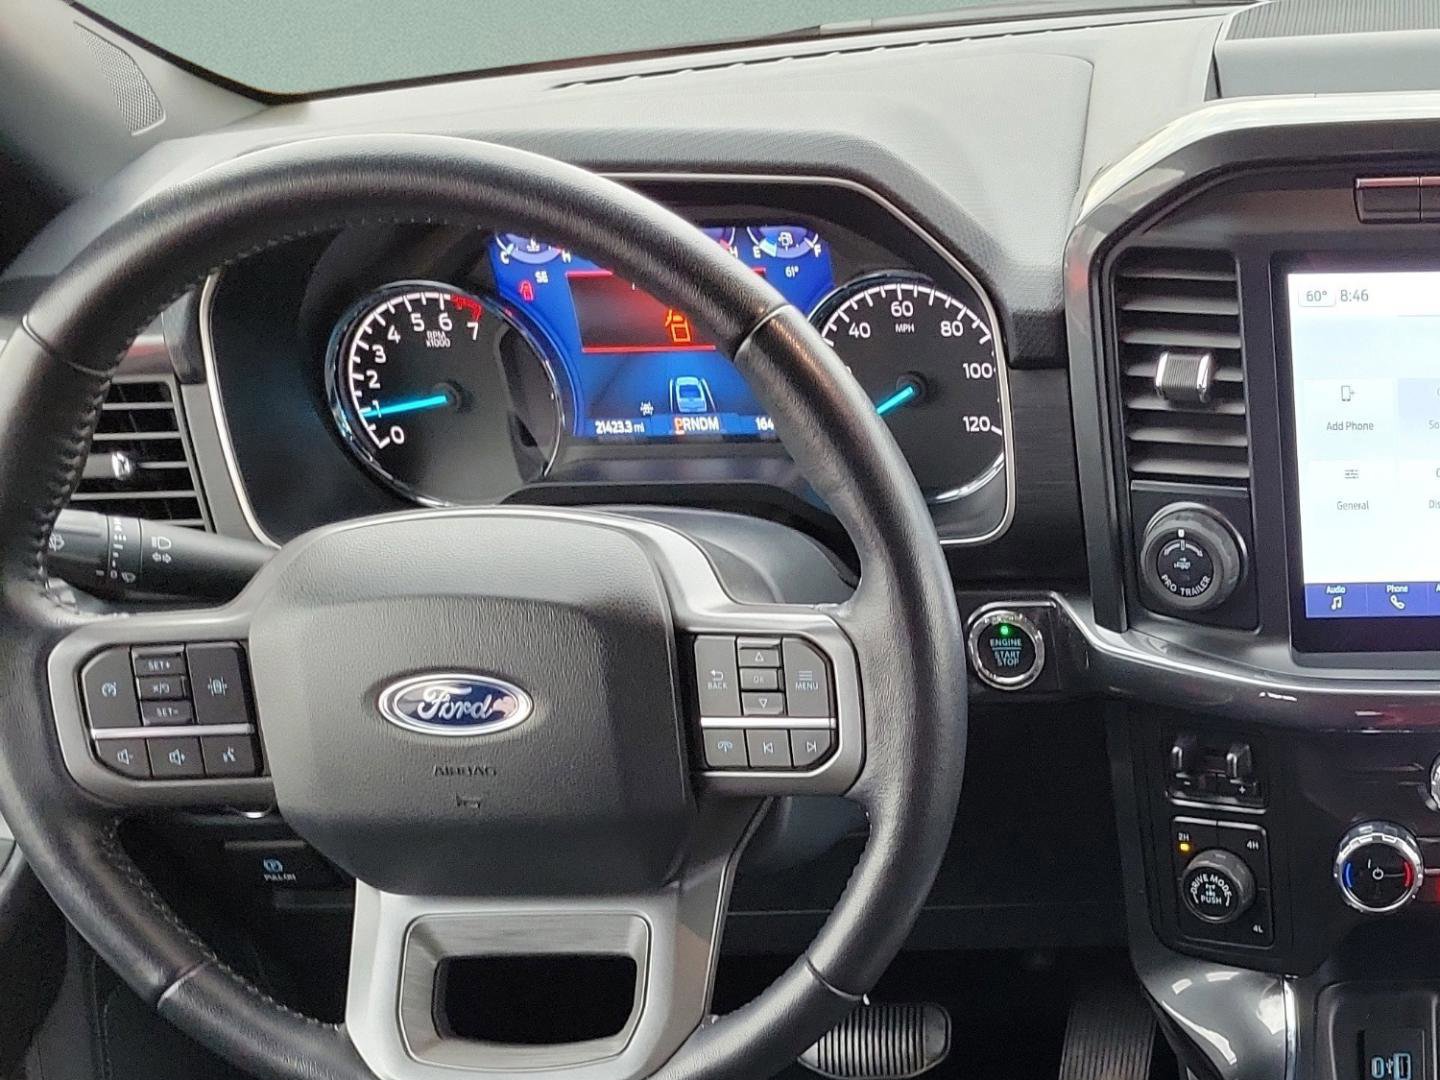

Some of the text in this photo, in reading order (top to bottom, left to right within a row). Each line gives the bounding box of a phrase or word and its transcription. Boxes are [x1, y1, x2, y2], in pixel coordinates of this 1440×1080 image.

[1306, 290, 1328, 302] 60°
[1340, 288, 1369, 303] 8:46
[891, 301, 914, 318] 60
[411, 313, 425, 331] 5
[438, 312, 453, 331] 6
[895, 323, 915, 333] MPH
[940, 321, 964, 337] 80
[387, 325, 401, 344] 4
[426, 330, 447, 341] RPM
[466, 321, 479, 340] 7
[849, 322, 871, 338] 40
[372, 344, 386, 363] 3
[963, 363, 993, 379] 100
[366, 369, 381, 389] 2
[372, 400, 382, 418] 1
[963, 416, 991, 432] 120
[1326, 421, 1375, 431] Add Phone
[390, 425, 405, 444] 0
[1336, 500, 1370, 511] General
[1160, 574, 1212, 598] PRO TRAILER
[1326, 585, 1346, 595] Audio
[1386, 584, 1408, 593] Phone
[989, 638, 1022, 647] ENGINE
[994, 650, 1020, 659] START
[997, 657, 1020, 667] STOP
[708, 682, 728, 690] BACK
[795, 682, 819, 690] MENU
[416, 685, 495, 720] Ford
[1178, 832, 1190, 842] 2H
[1246, 840, 1259, 850] 4H
[1190, 873, 1232, 898] DRIVE MODE
[1200, 895, 1222, 905] PUSH
[1252, 924, 1263, 934] 4L
